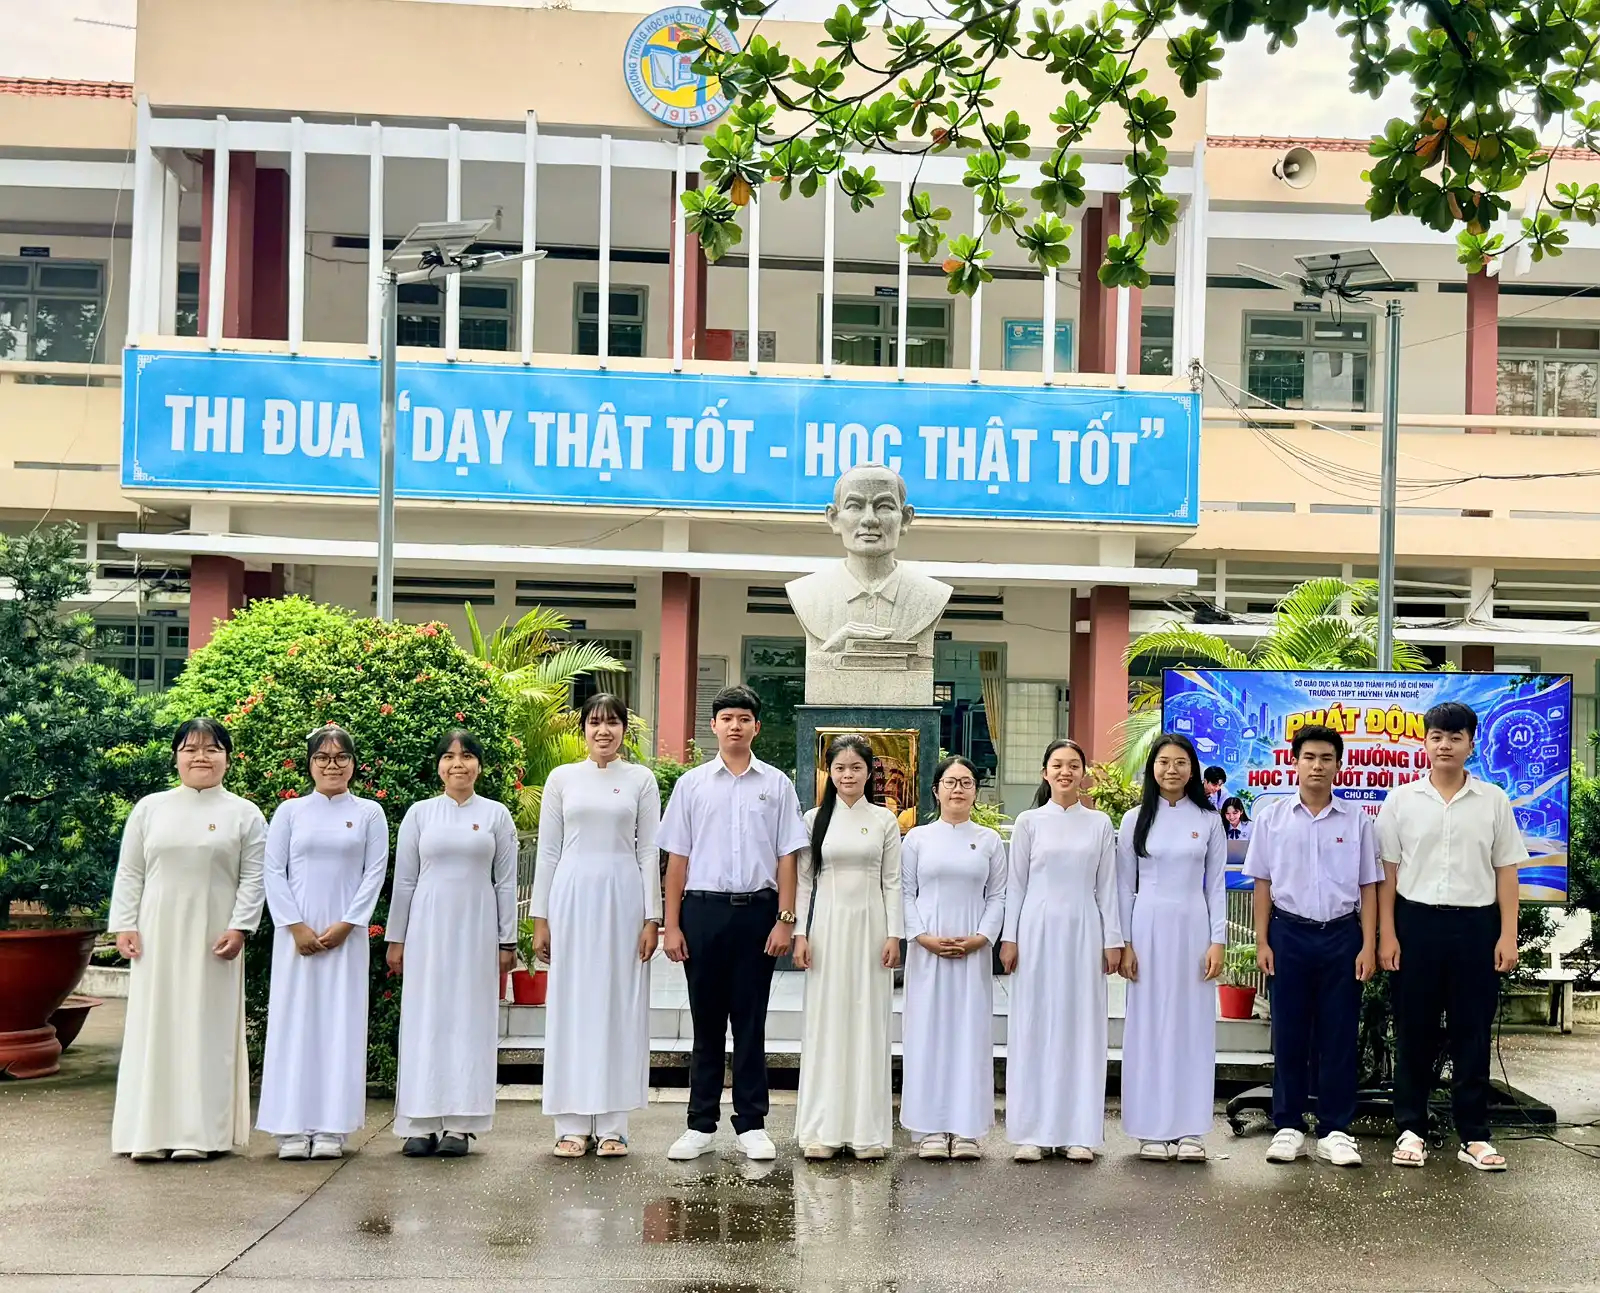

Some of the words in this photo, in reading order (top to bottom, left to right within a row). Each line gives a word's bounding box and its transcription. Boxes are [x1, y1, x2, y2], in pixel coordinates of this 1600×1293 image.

[645, 18, 663, 34] HỌC
[664, 8, 682, 24] PHỔ
[684, 13, 708, 28] THÔN
[629, 31, 648, 60] TRUNG
[629, 61, 646, 98] TRƯỜNG
[651, 102, 717, 122] 1959
[165, 394, 244, 453] THI
[262, 399, 364, 459] ĐUA
[528, 402, 651, 482] THẬT
[666, 398, 754, 474] TỐT
[919, 416, 1037, 494] THẬT
[1308, 688, 1336, 697] TRƯỜNG
[1357, 688, 1383, 698] HUỲNH
[1400, 689, 1420, 699] NGHỆ
[1286, 702, 1361, 742] PHÁT
[1365, 704, 1425, 743] ĐỘN
[1513, 730, 1528, 742] AI
[1347, 743, 1409, 769] HƯỞNG
[1248, 769, 1282, 790] HỌC
[1332, 766, 1363, 787] UỐT
[1366, 768, 1393, 788] ĐỜI
[1398, 769, 1425, 786] NĂ
[1344, 789, 1361, 799] CHỦ
